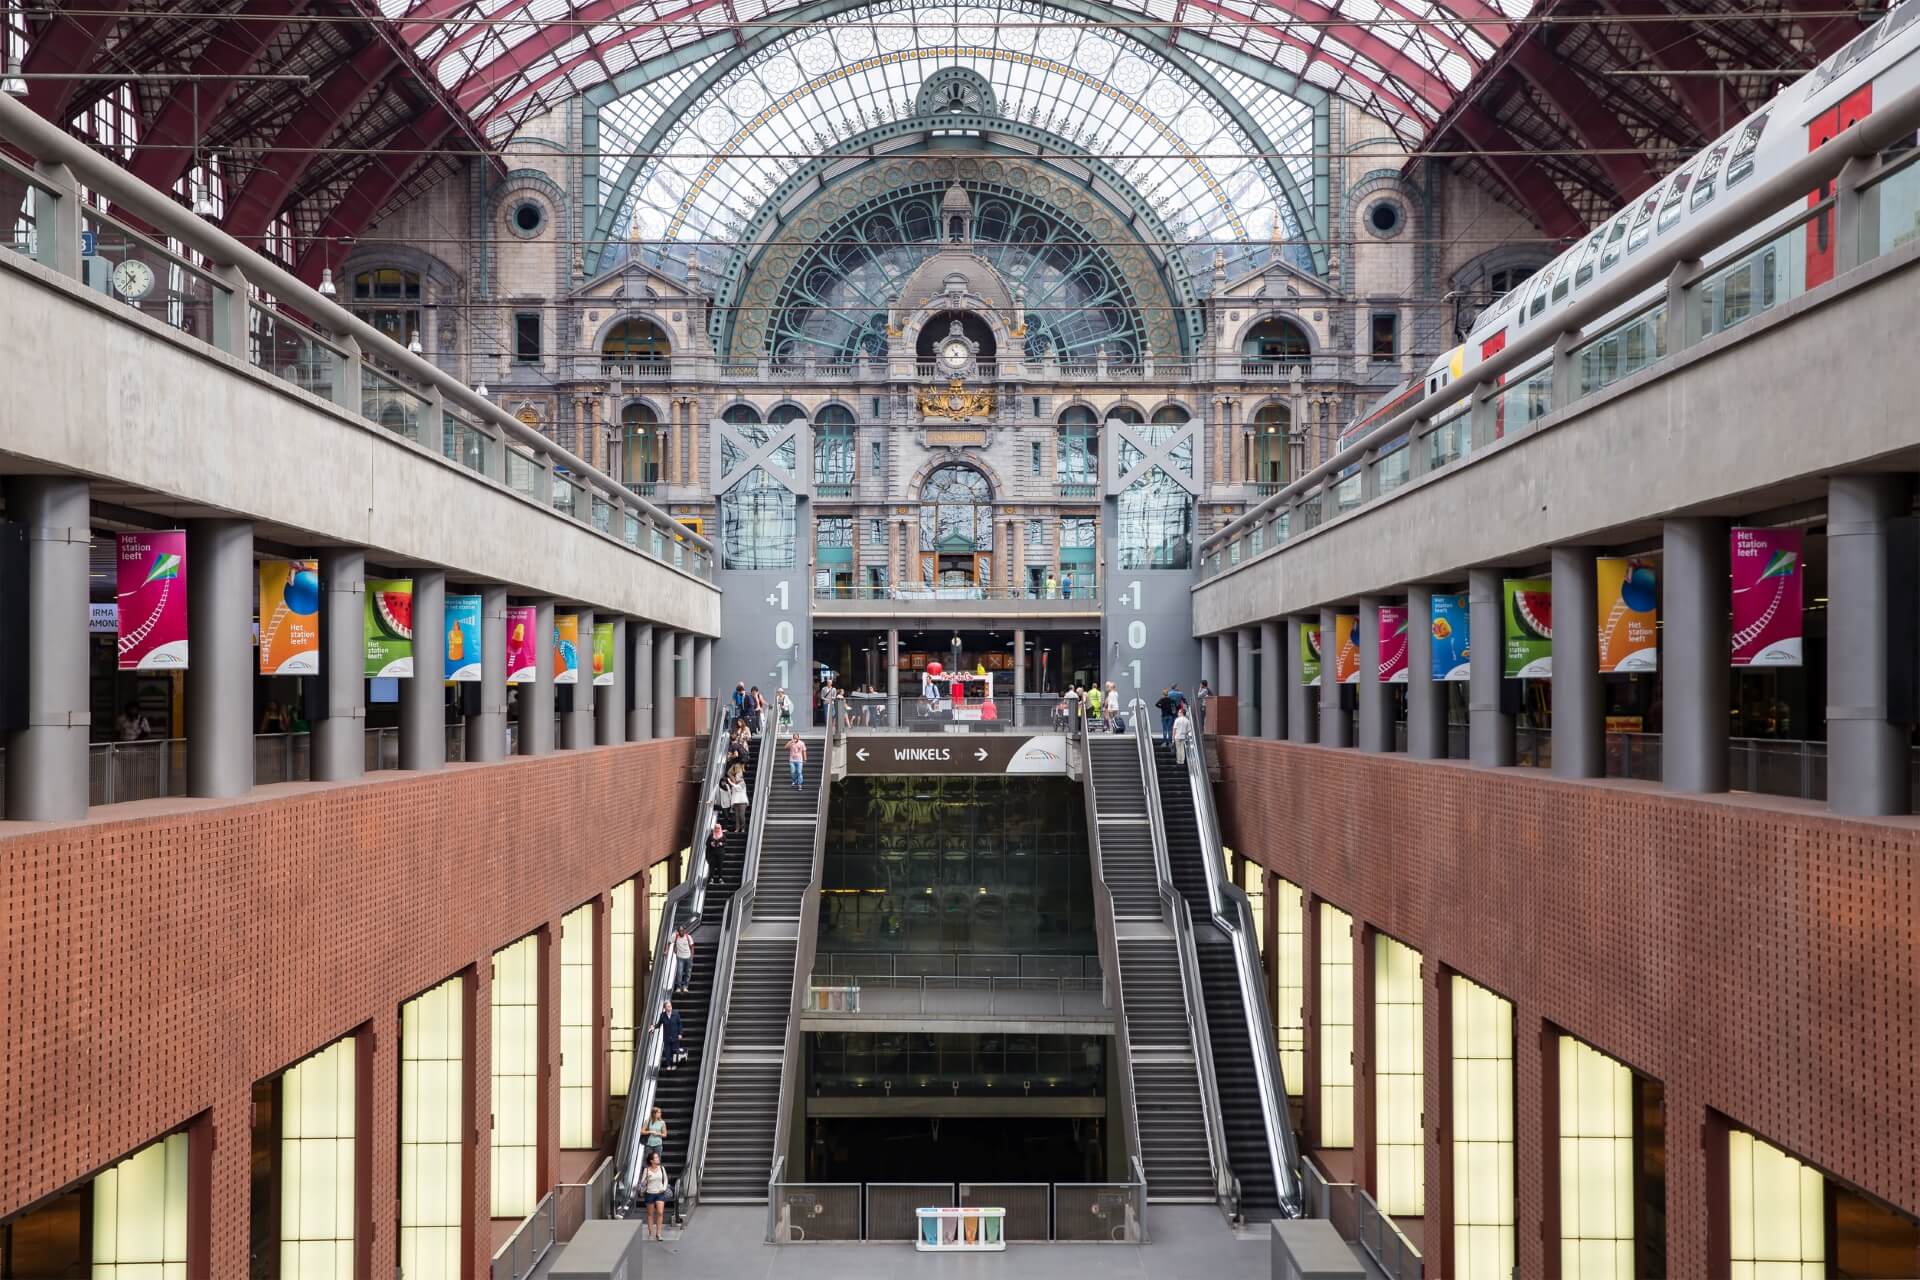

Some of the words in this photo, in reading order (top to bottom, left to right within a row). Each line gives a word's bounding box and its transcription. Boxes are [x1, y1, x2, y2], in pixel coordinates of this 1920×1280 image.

[121, 535, 137, 543] Het
[1737, 531, 1753, 540] Het
[1737, 540, 1768, 548] station
[121, 552, 143, 560] leeft
[1737, 548, 1758, 557] leeft
[766, 581, 789, 610] +1
[1118, 581, 1142, 610] +1
[92, 608, 114, 617] IRMA
[1628, 621, 1641, 629] Het
[290, 631, 315, 639] station
[775, 621, 794, 650] 0
[1128, 620, 1147, 649] 0
[768, 660, 789, 689] -1
[1120, 660, 1142, 689] -1
[894, 748, 951, 761] WINKELS
